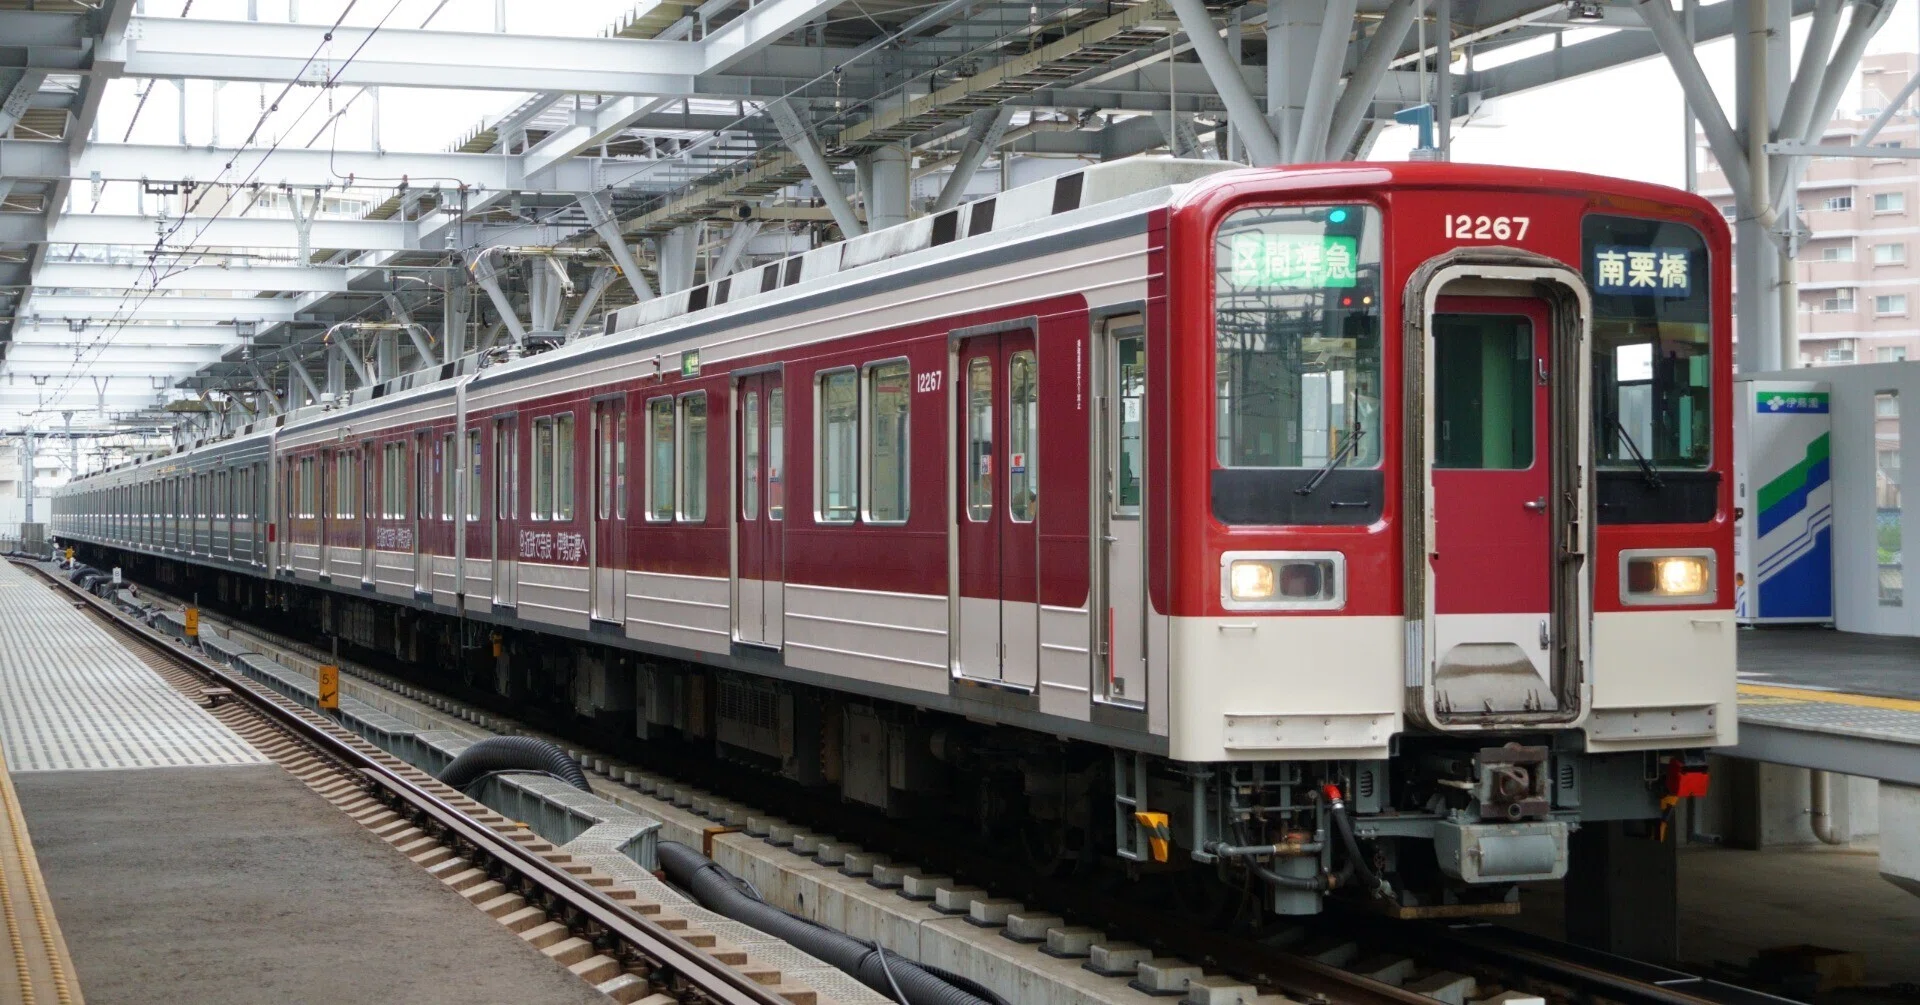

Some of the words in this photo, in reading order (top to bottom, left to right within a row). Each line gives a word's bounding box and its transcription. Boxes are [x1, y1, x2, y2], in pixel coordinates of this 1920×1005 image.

[1445, 214, 1531, 241] 12267
[1234, 241, 1354, 279] 区間準急
[1596, 250, 1689, 288] 南栗橋
[917, 370, 942, 393] 12267
